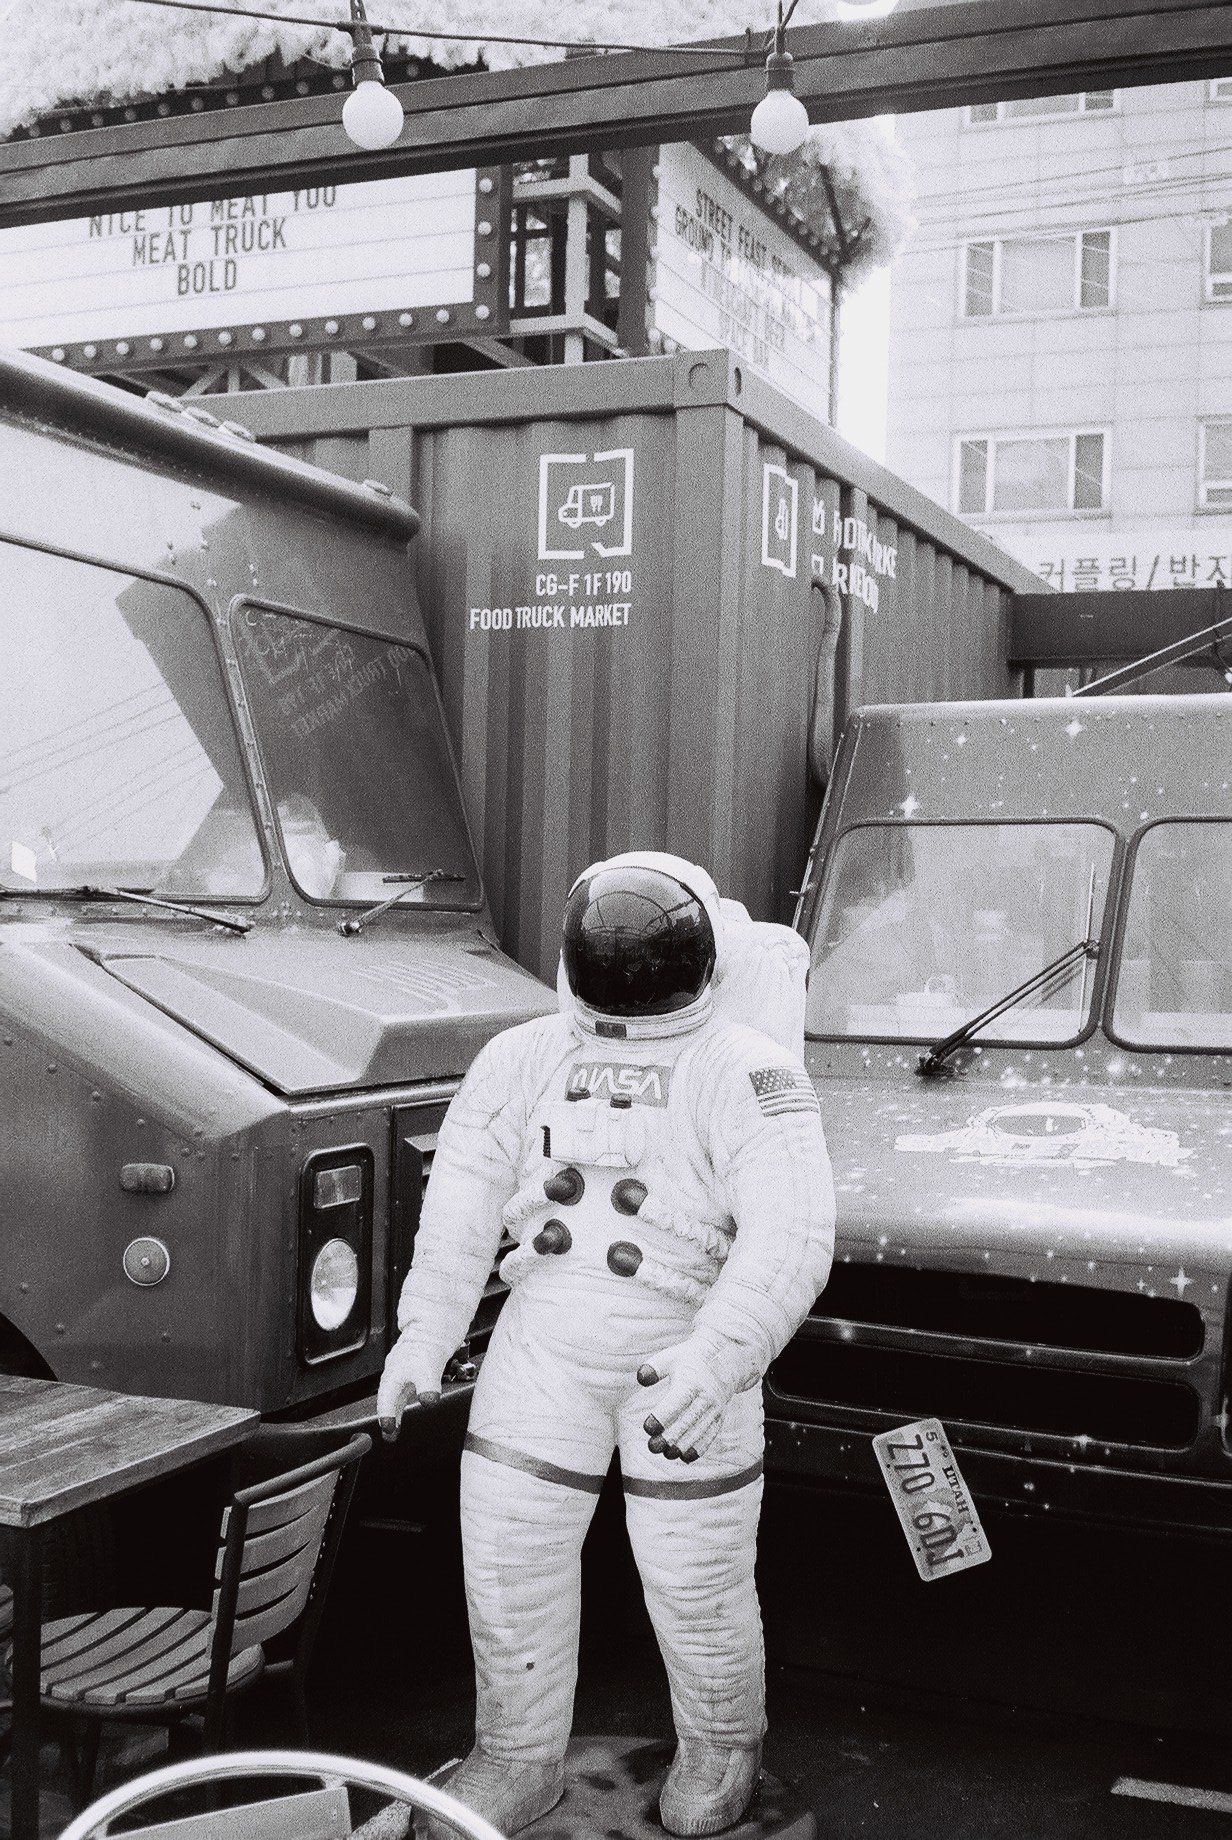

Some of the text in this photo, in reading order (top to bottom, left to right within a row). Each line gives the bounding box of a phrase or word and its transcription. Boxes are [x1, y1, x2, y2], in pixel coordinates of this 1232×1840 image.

[88, 210, 146, 238] NICE
[210, 194, 269, 222] MEAT
[696, 188, 733, 246] STREET
[738, 224, 768, 273] FEAST
[132, 217, 287, 266] MEAT TRUCK
[177, 258, 237, 296] BOLD
[535, 573, 580, 597] CG-F
[469, 602, 632, 630] FOOD TRUCK MARKET
[572, 1066, 662, 1100] NASA
[942, 1465, 970, 1514] UTAH
